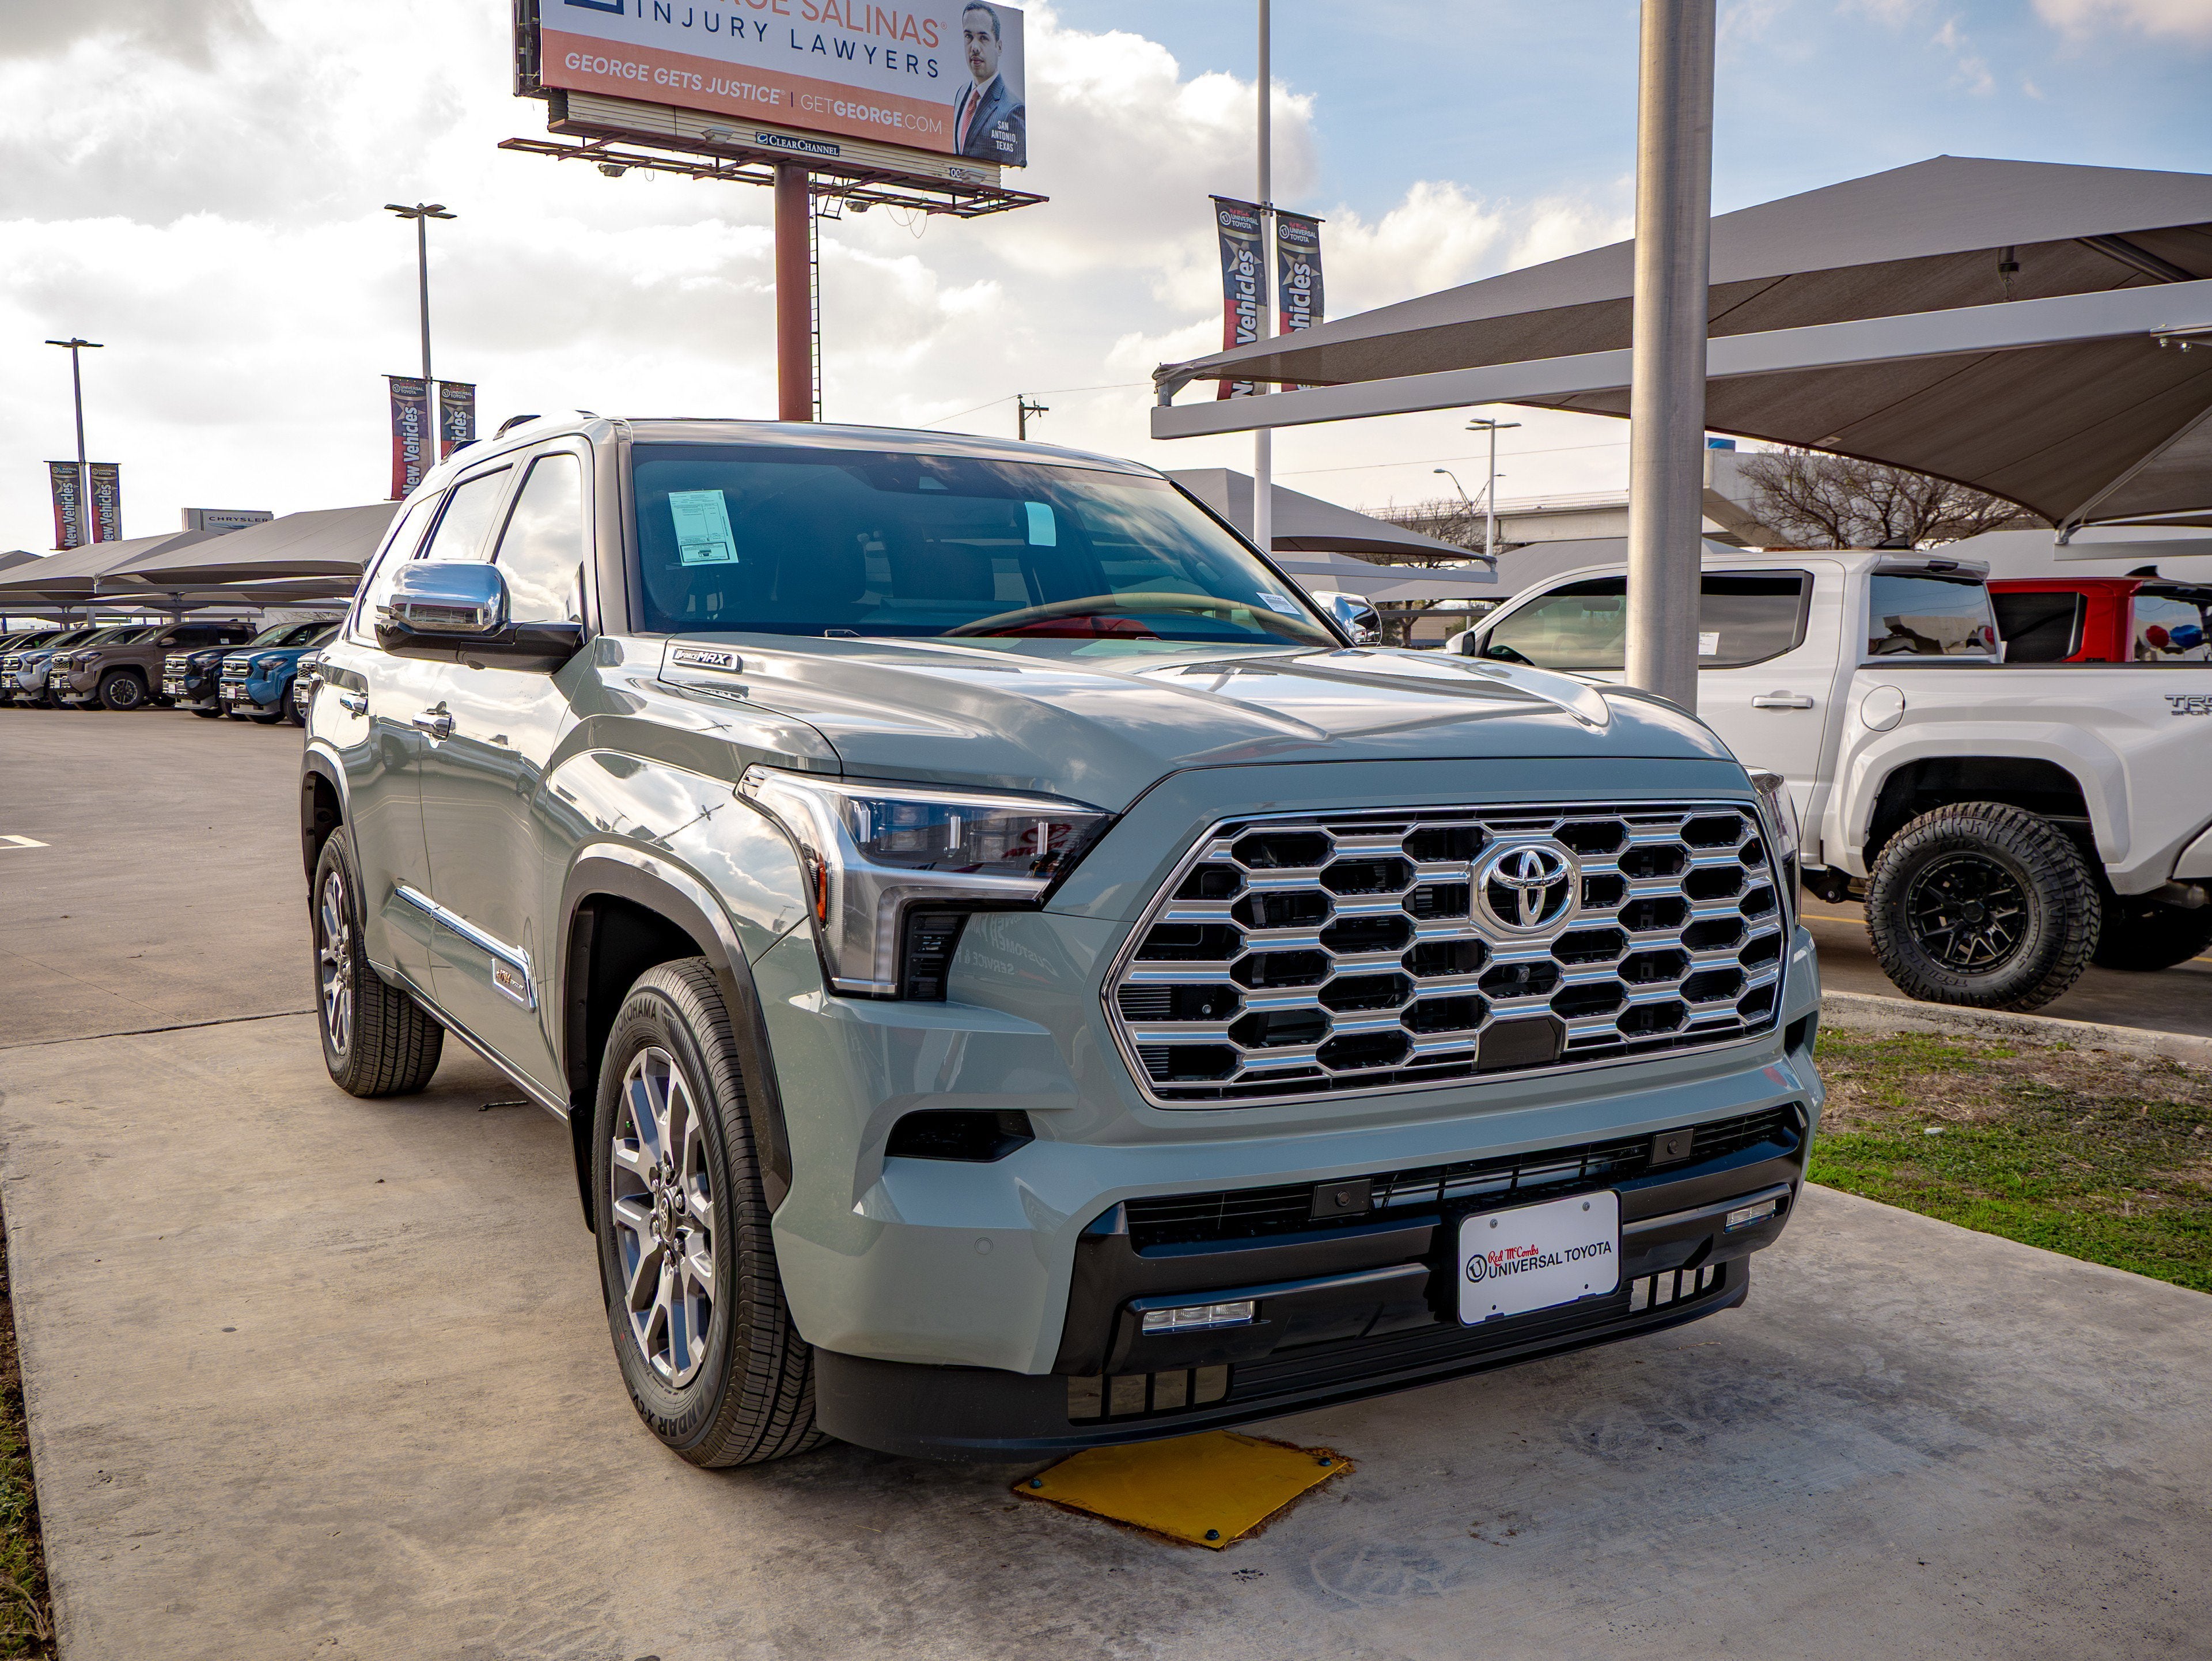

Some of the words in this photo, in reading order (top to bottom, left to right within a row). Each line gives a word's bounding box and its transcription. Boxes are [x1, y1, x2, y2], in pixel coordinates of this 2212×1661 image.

[638, 0, 768, 42] INJURY
[791, 29, 938, 78] LAWYERS
[565, 52, 650, 81] GEORGE
[654, 68, 703, 91] GETS
[801, 94, 942, 135] GETGEORGE.COM
[991, 130, 1017, 144] ANTONIO,
[998, 120, 1009, 131] SAN
[996, 141, 1014, 152] TEXAS
[1231, 214, 1259, 225] UNIVERSAL
[1232, 220, 1252, 229] TOYOTA
[1290, 227, 1317, 238] UNIVERSAL
[1290, 233, 1309, 243] TOYOTA
[1236, 249, 1256, 344] Vehicles
[1289, 263, 1311, 332] hicles
[403, 406, 419, 462] Vehicles
[451, 411, 467, 444] icles
[61, 482, 76, 523] Vehicles
[99, 484, 113, 524] Vehicles
[64, 525, 78, 547] New
[614, 998, 657, 1037] YOKOHAMA
[1488, 1250, 1503, 1266] Red
[1504, 1244, 1539, 1260] McCombs
[1488, 1252, 1563, 1278] UNIVERSAL
[1565, 1240, 1612, 1262] TOYOTA
